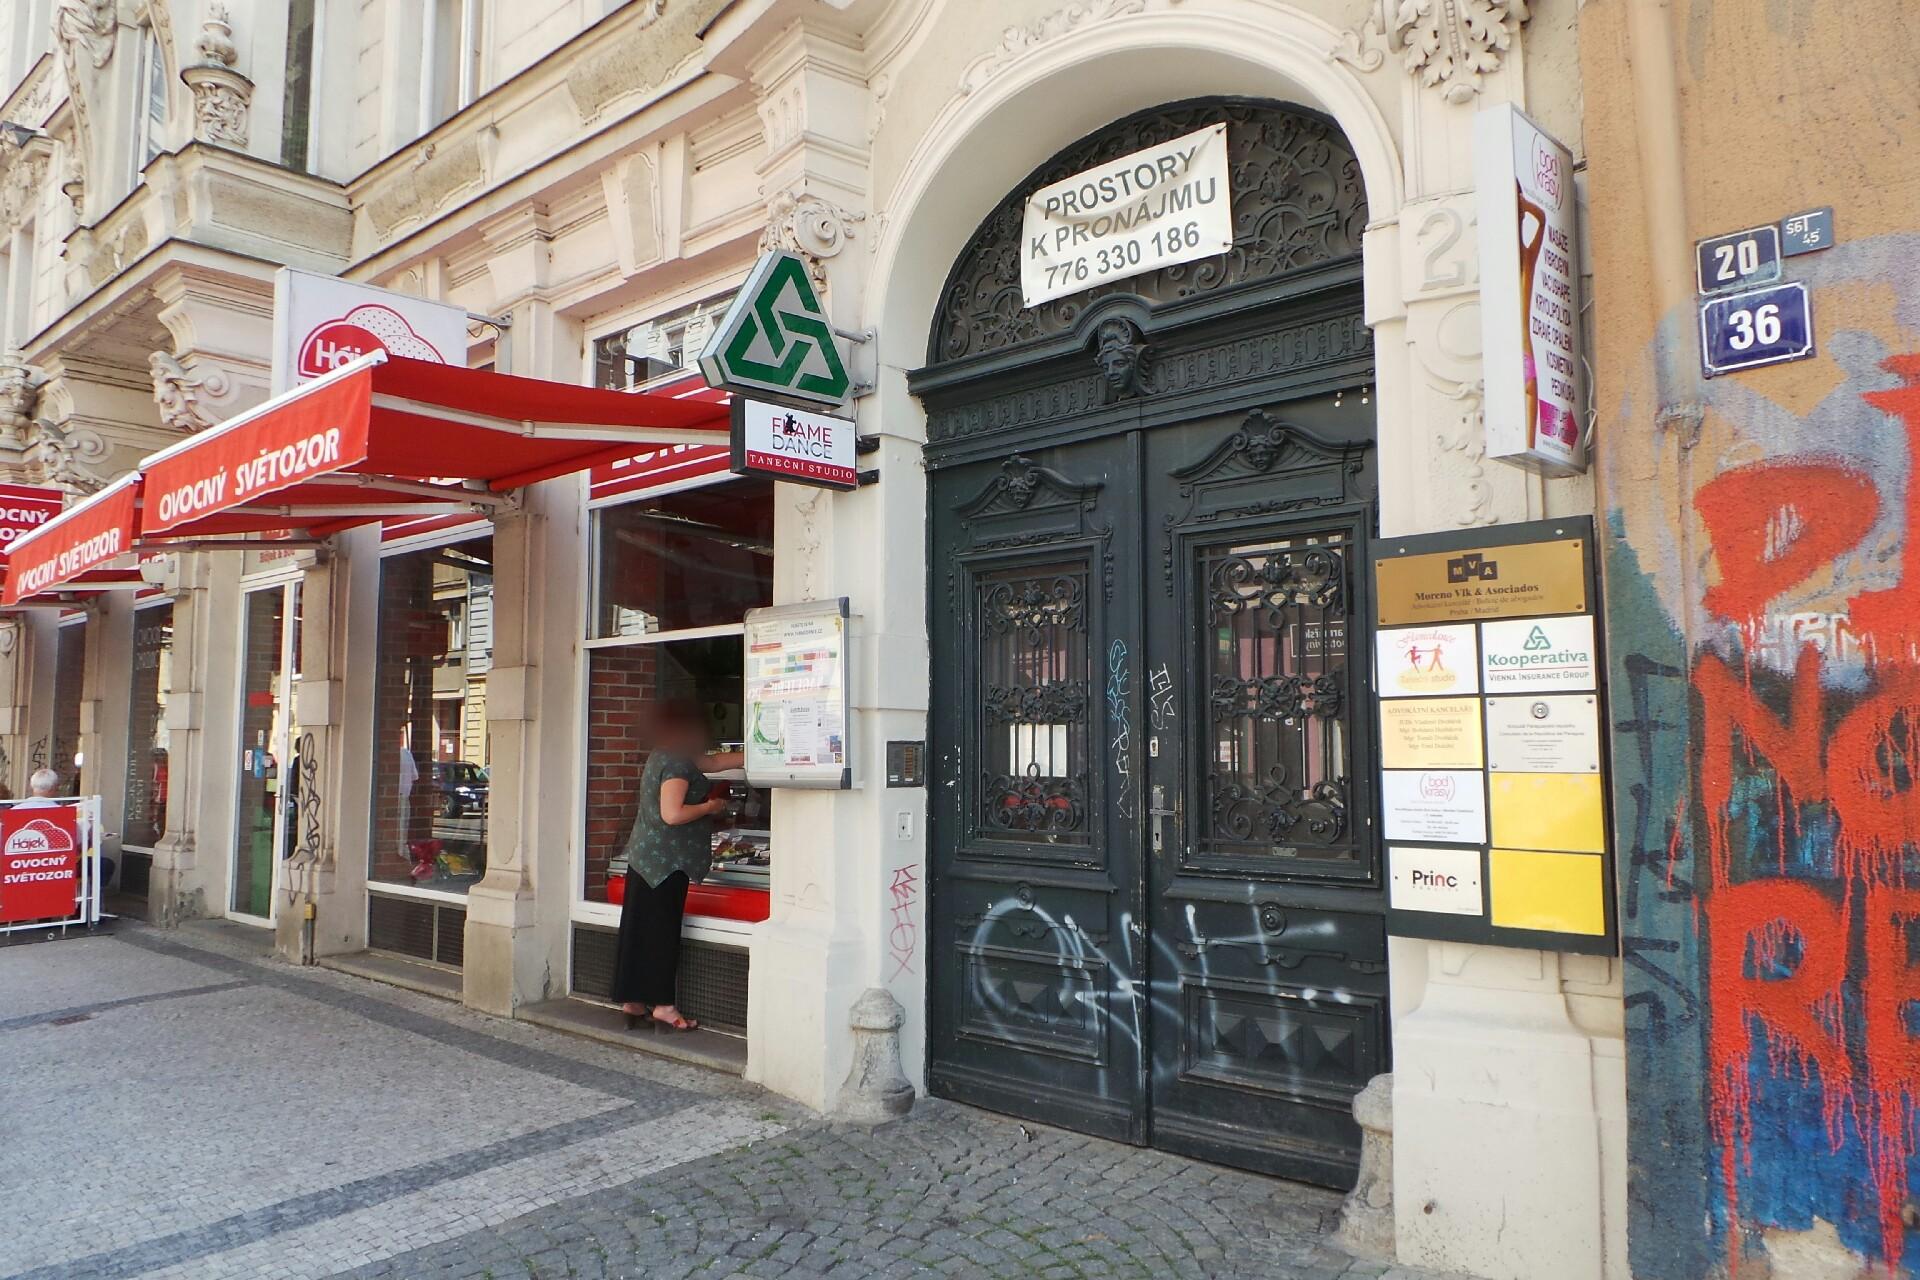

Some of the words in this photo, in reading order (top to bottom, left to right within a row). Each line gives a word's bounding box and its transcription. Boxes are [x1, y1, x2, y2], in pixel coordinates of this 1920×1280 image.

[1044, 145, 1197, 220] PROSTORY
[1031, 233, 1048, 259] K
[1056, 177, 1216, 252] PRONÁJMU
[1045, 256, 1089, 289] 776
[1096, 240, 1141, 274] 330
[1151, 221, 1200, 257] 186
[1714, 239, 1759, 281] 20
[1729, 304, 1781, 350] 36
[772, 434, 832, 460] DANCE
[159, 466, 226, 521] OVOCNÝ
[235, 428, 339, 495] SVĚTOZOR
[808, 464, 853, 479] STUDIO
[58, 528, 120, 576] SVĚTOZOR
[1415, 591, 1452, 601] Moreno
[1455, 588, 1472, 597] Vlk
[1485, 583, 1539, 595] Asociados
[1488, 649, 1588, 668] Kooperativa
[4, 870, 73, 884] SVĚTOZOR
[10, 855, 68, 869] OVOCNÝ
[1412, 869, 1458, 888] Princ
